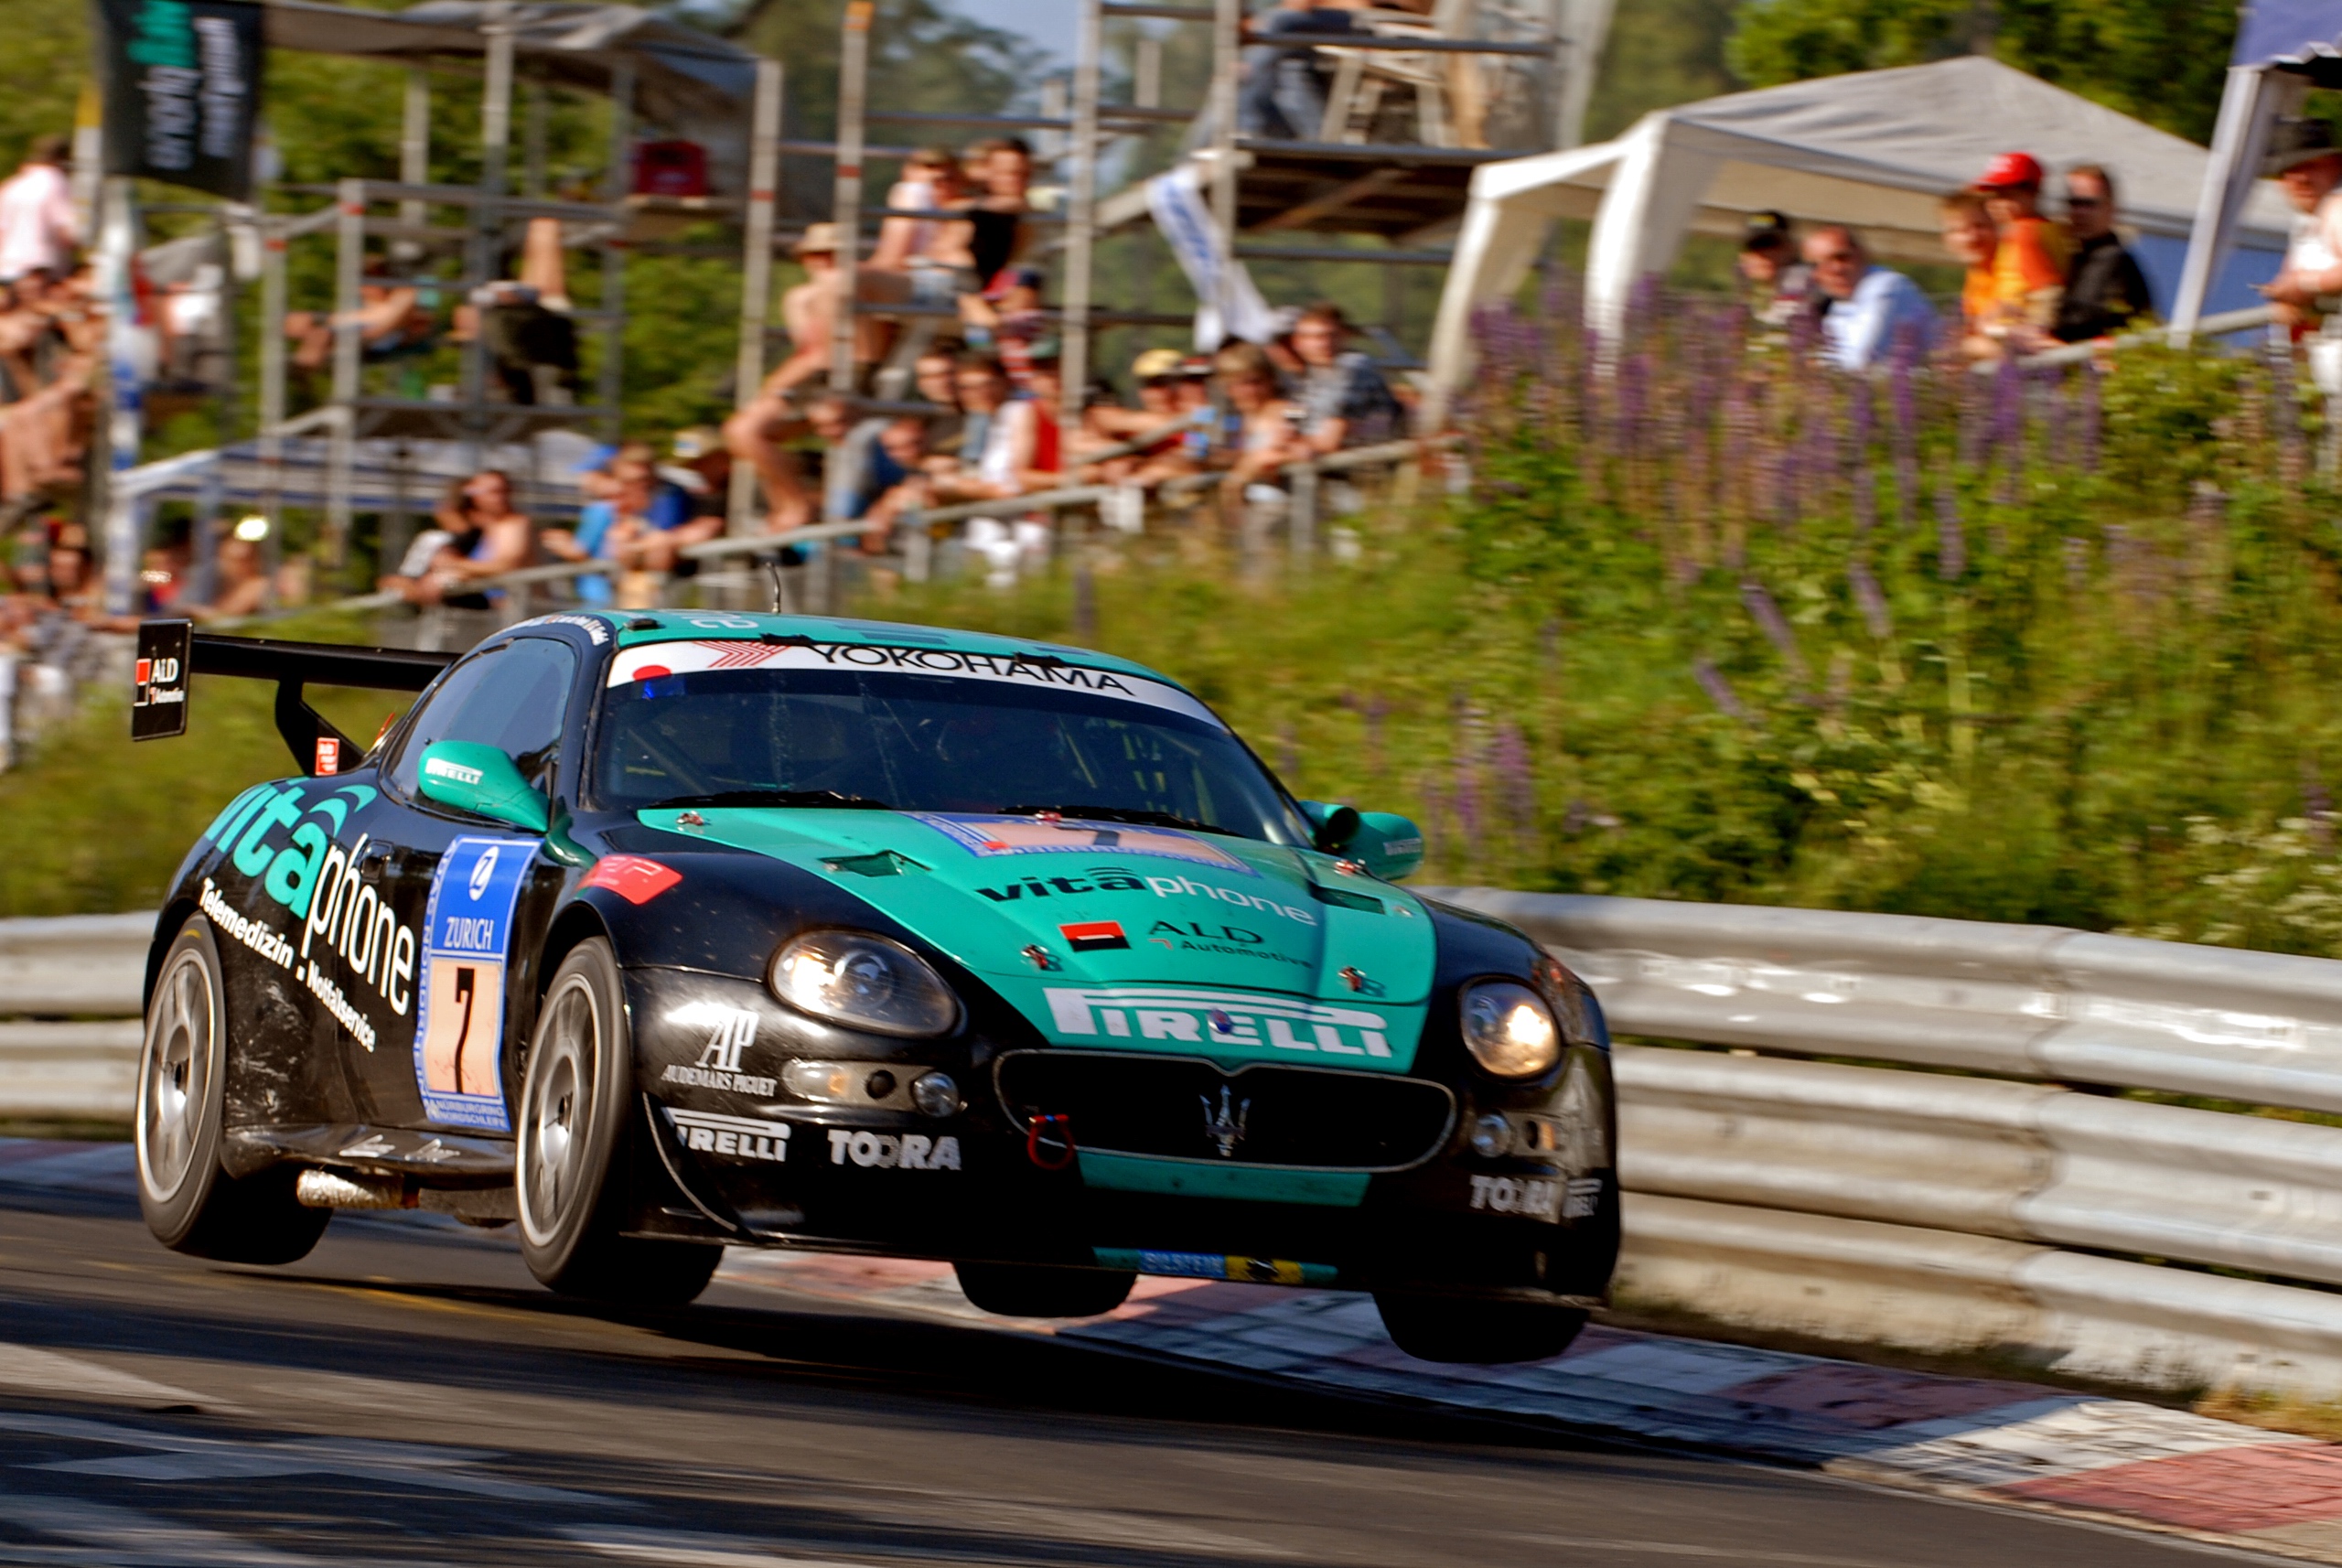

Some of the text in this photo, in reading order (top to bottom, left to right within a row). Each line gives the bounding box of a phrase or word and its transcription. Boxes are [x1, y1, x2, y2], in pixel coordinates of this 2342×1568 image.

[150, 658, 179, 683] ALD
[809, 643, 1135, 696] YOKOHAMA
[199, 877, 295, 969] Telemedizin
[975, 874, 1317, 927] vitaphone
[444, 916, 494, 950] ZURICH
[1149, 920, 1264, 944] ALD
[1181, 940, 1315, 970] Automotive
[456, 967, 475, 1095] 7
[694, 1009, 759, 1073] AP
[1043, 987, 1391, 1058] PIRELLI
[661, 1064, 778, 1097] AUDEMARS PIGUET
